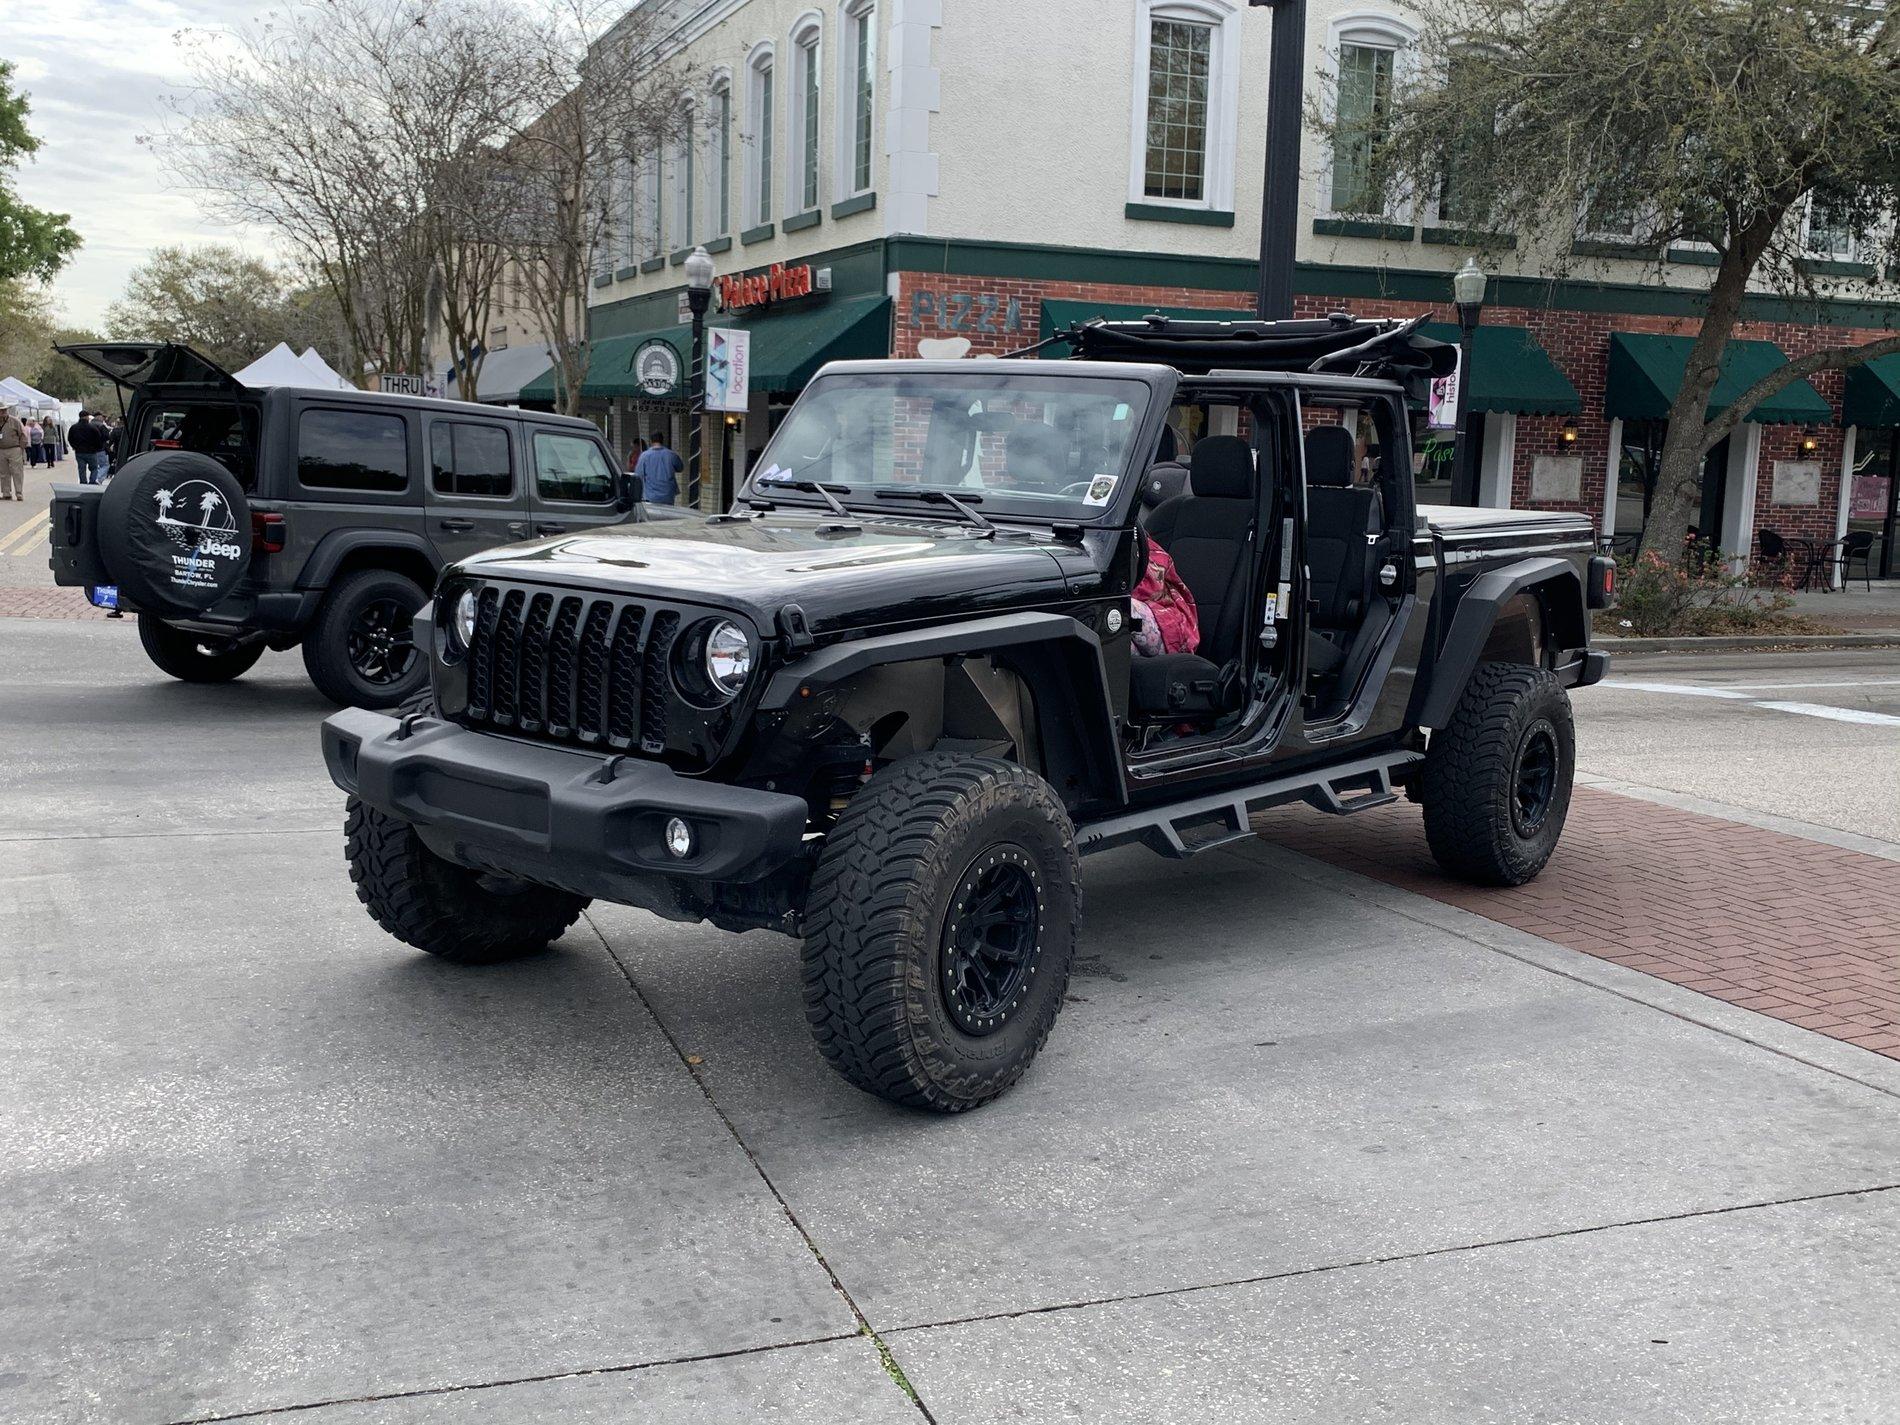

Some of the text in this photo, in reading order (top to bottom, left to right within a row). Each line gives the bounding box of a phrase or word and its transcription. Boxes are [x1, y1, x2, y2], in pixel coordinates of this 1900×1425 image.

[721, 274, 769, 309] Palace
[769, 263, 812, 301] Pizza
[911, 290, 1023, 334] PIZZA
[731, 344, 745, 395] location
[383, 376, 420, 394] THRU
[199, 538, 241, 561] Jeep
[171, 554, 216, 569] THUNDER
[204, 571, 215, 581] FL
